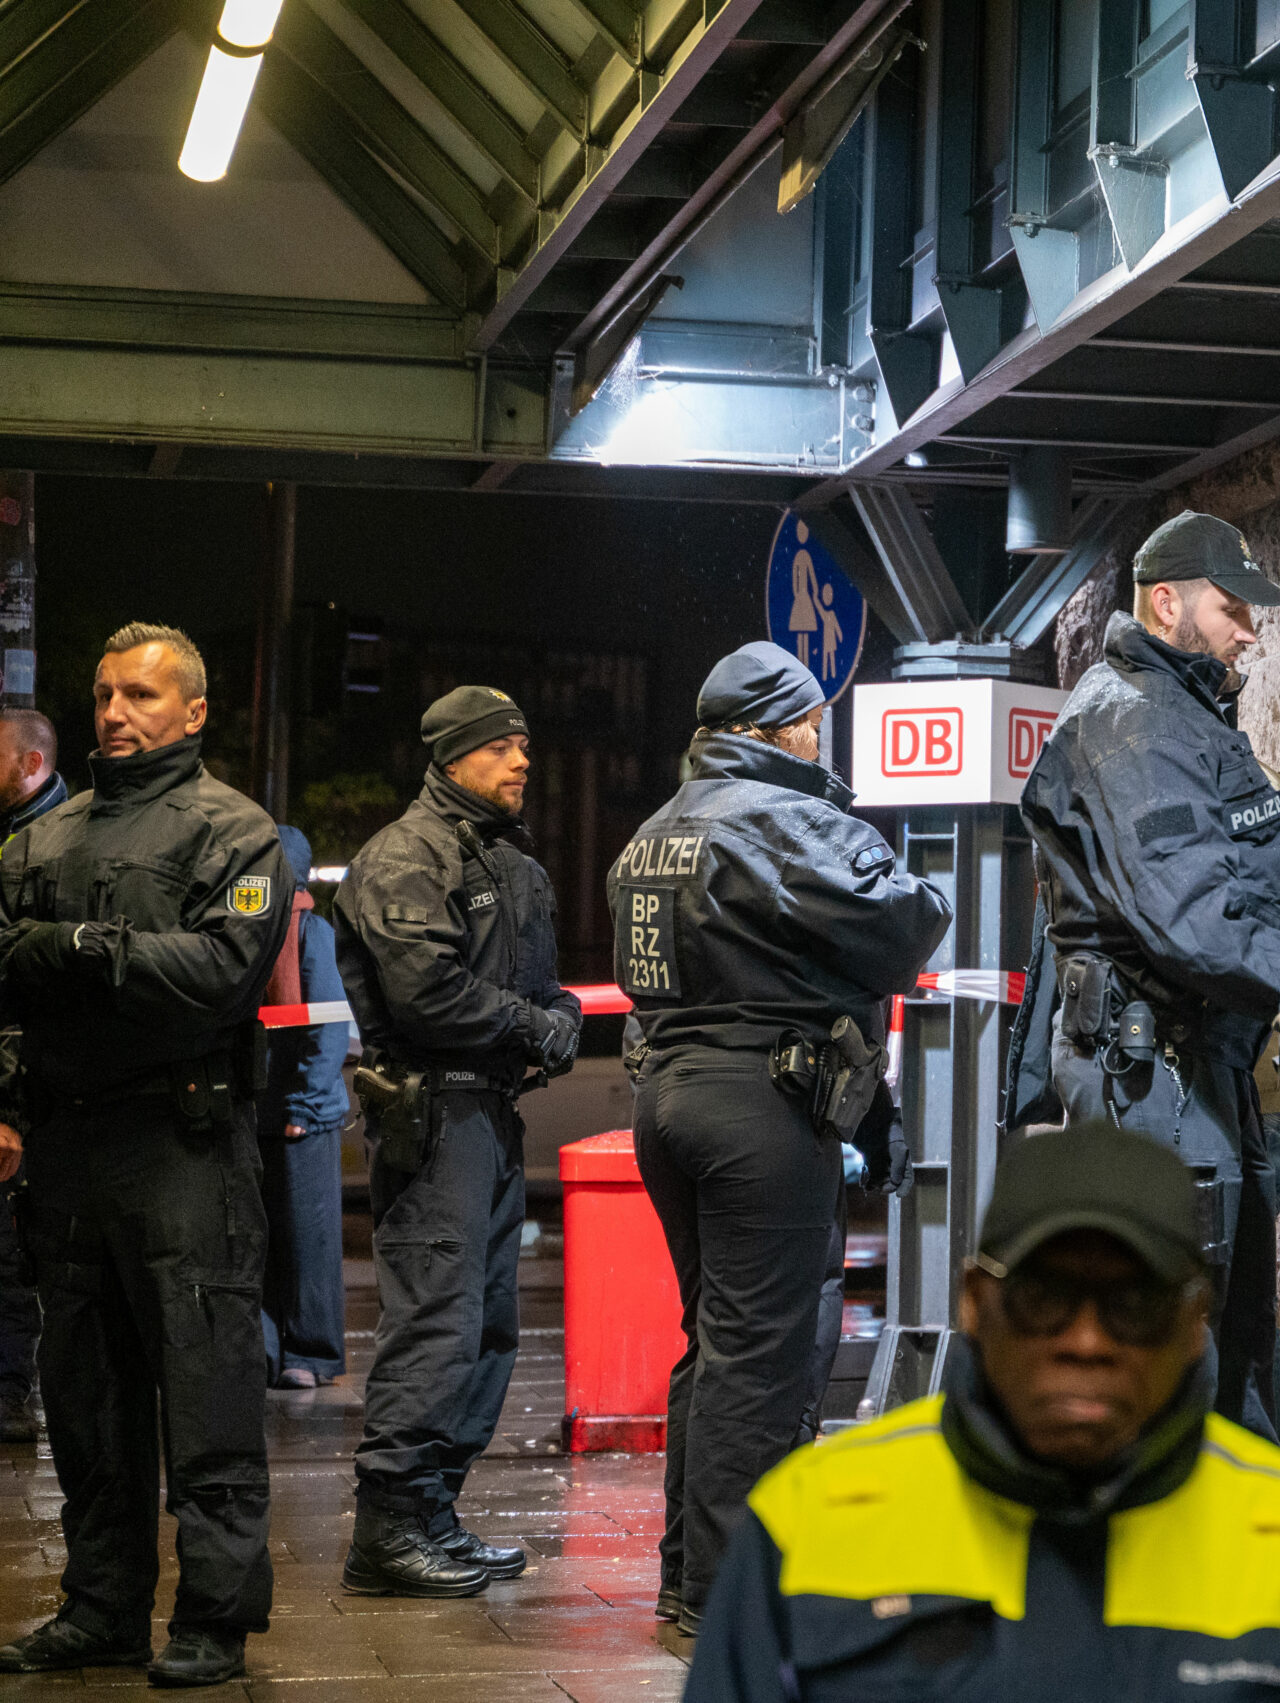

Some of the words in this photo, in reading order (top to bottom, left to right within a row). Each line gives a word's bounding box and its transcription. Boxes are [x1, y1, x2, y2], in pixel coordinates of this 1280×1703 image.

[891, 719, 953, 766] DB
[617, 836, 704, 878] POLIZEI
[632, 893, 660, 923] BP
[631, 925, 661, 957] RZ
[629, 957, 670, 990] 2311
